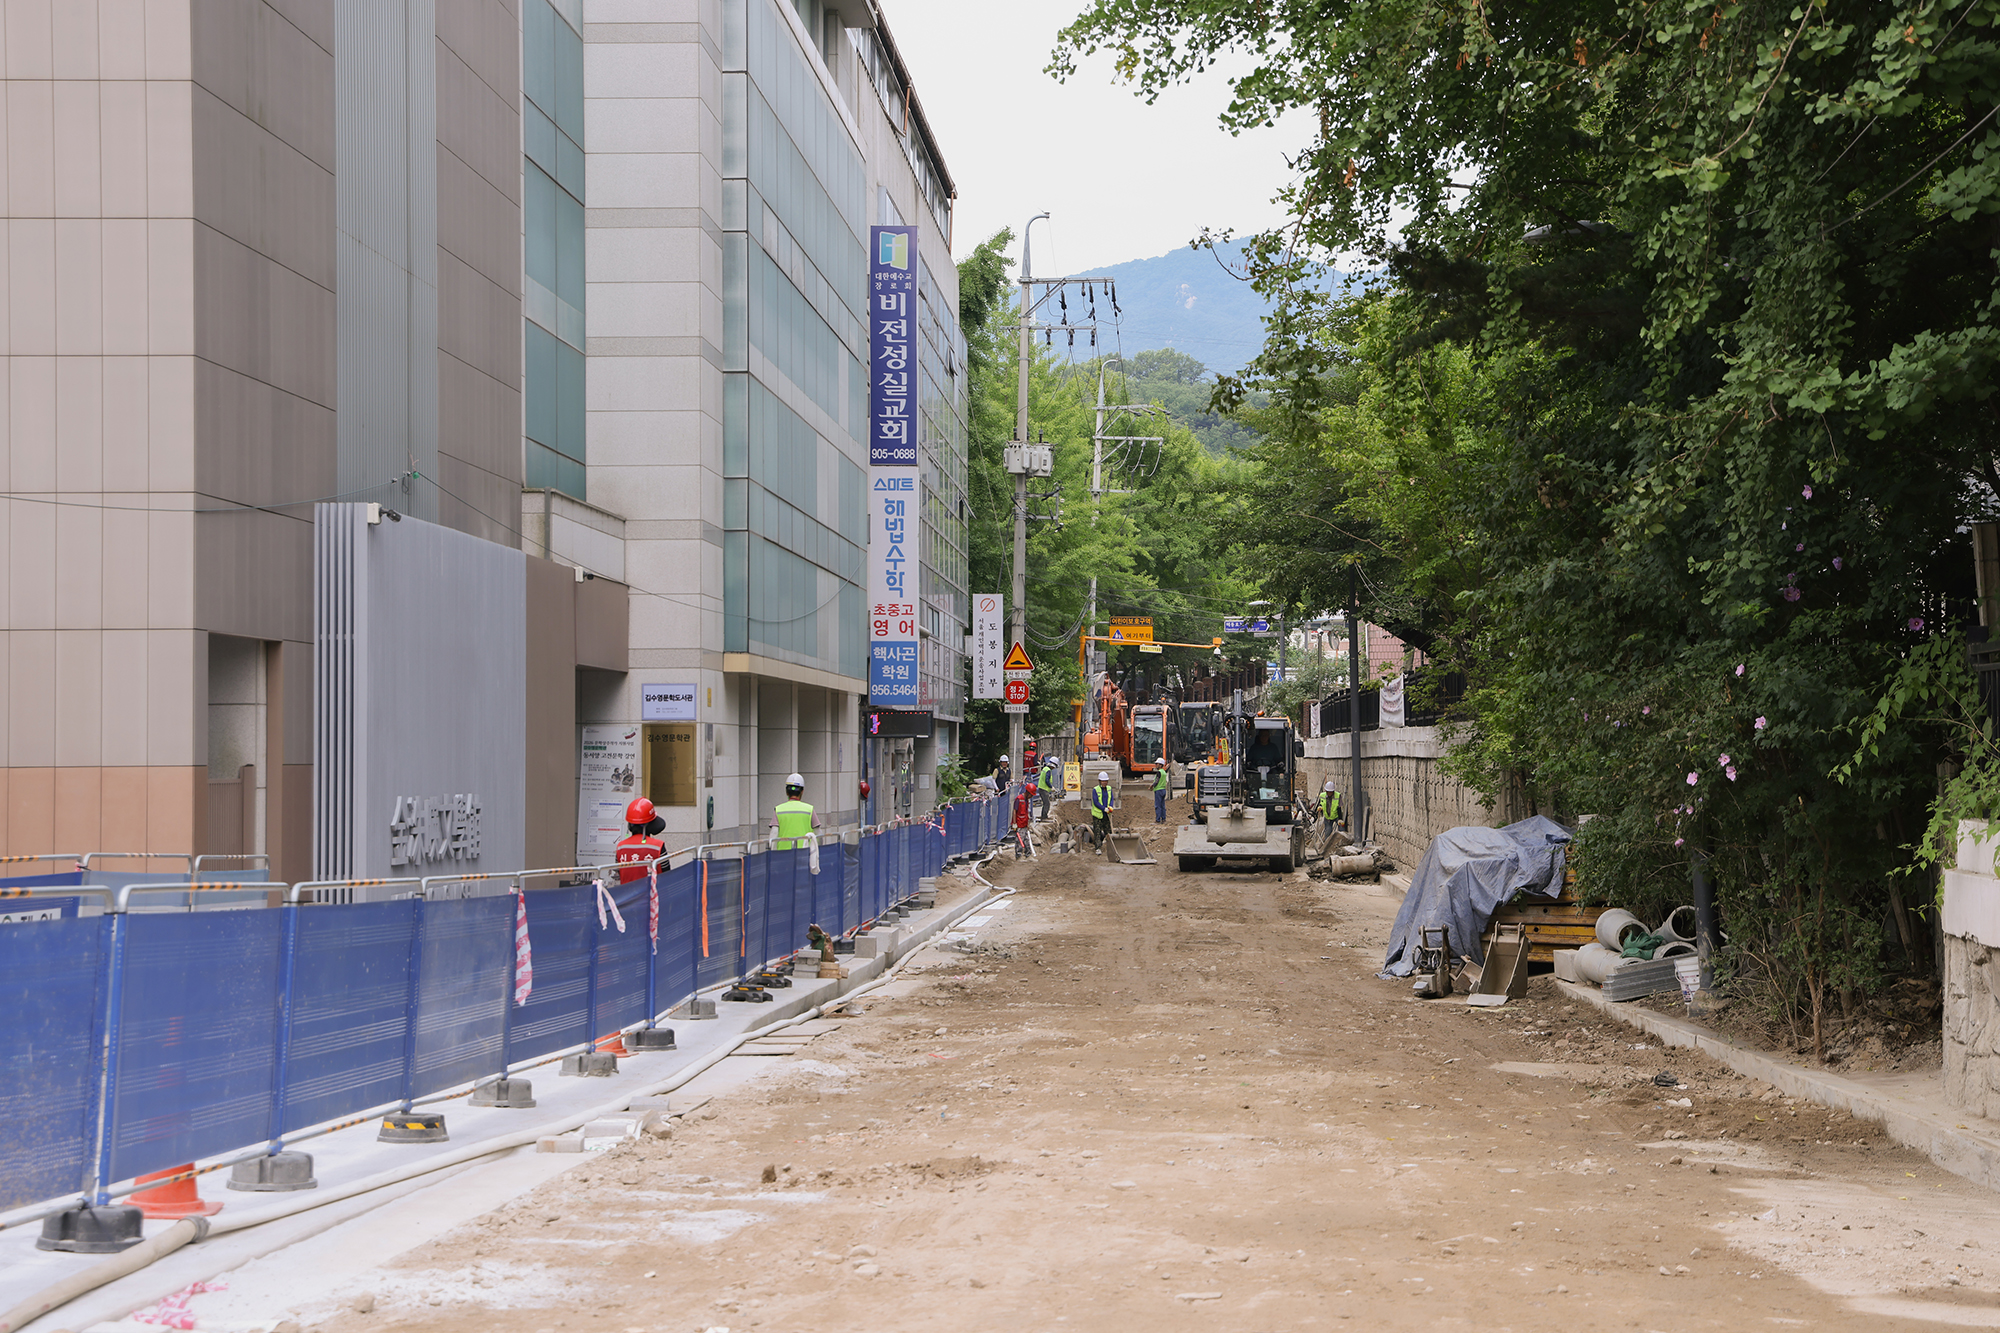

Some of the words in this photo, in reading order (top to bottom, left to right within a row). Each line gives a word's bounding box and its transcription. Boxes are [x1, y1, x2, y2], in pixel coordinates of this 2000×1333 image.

[875, 273, 912, 281] 대한예수교
[878, 292, 909, 445] 비전성실교회
[871, 449, 915, 459] 905-0688
[874, 478, 914, 491] 스마트
[884, 498, 905, 598] 해법수학
[874, 603, 914, 617] 초중고
[1111, 617, 1151, 625] 어린이보호구역
[873, 647, 916, 661] 핵사곤
[988, 623, 998, 688] 도봉지부
[882, 665, 909, 680] 학원
[871, 684, 917, 696] 956.5464
[645, 694, 693, 702] 김수영문학도서관
[647, 734, 690, 742] 김수영문학관
